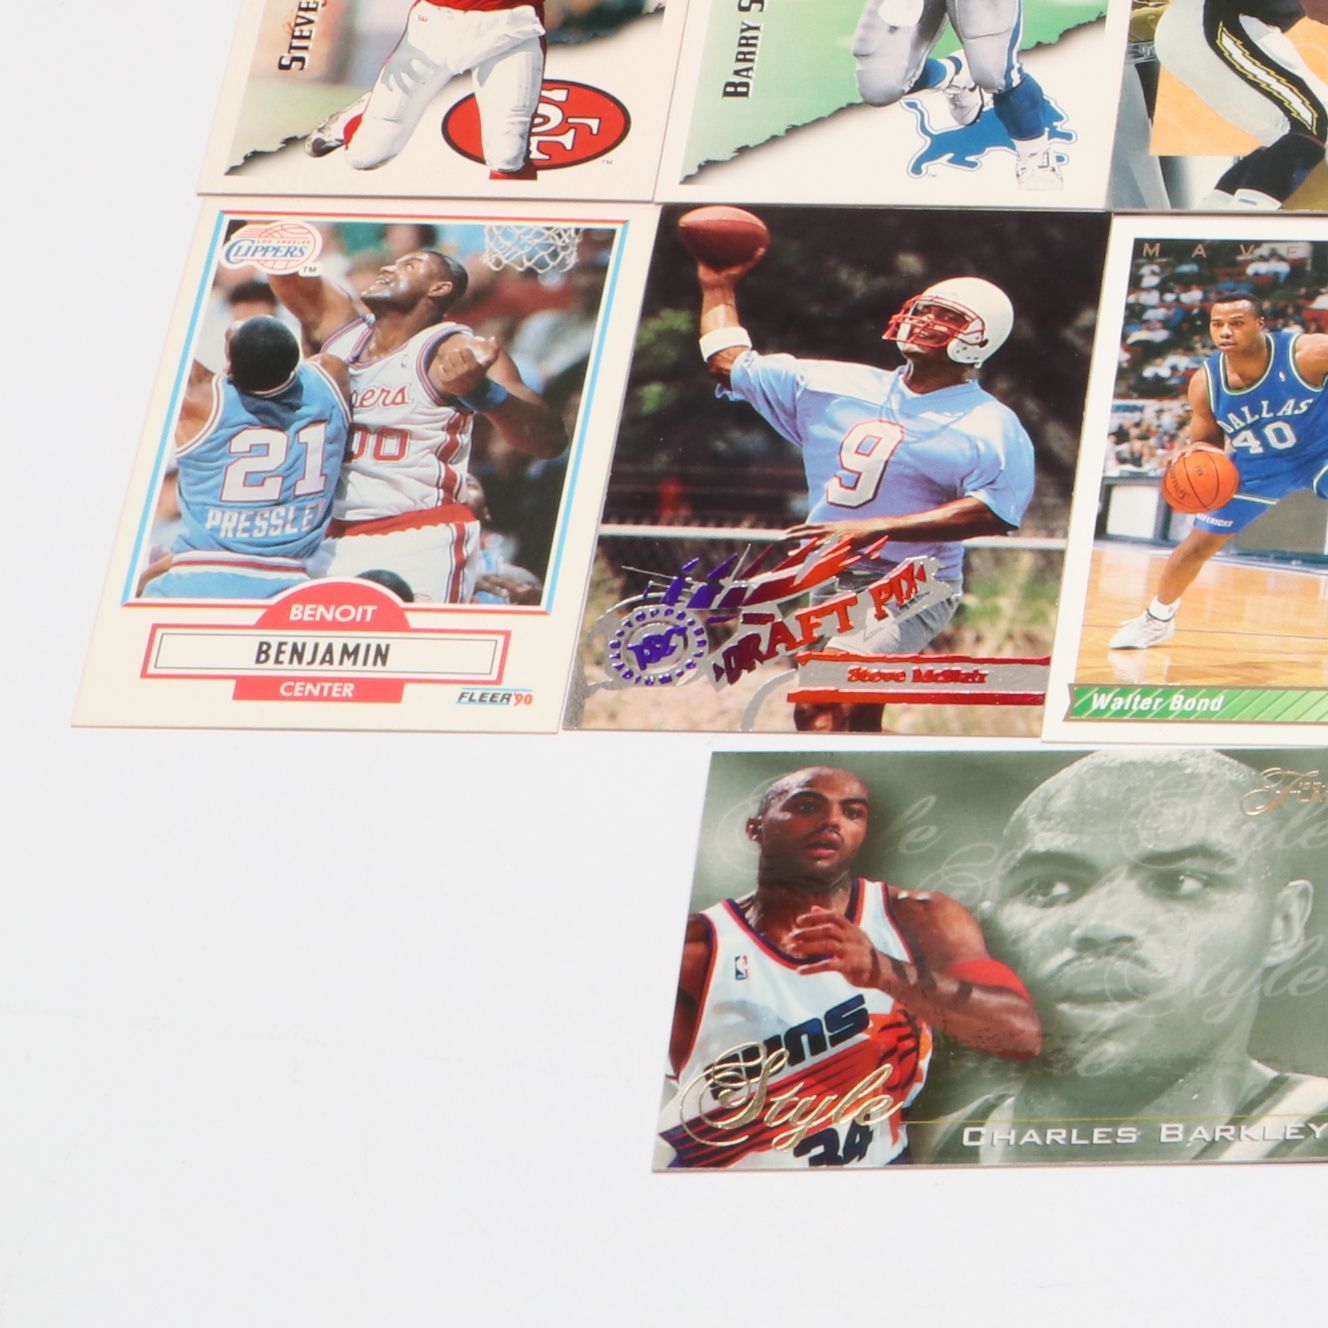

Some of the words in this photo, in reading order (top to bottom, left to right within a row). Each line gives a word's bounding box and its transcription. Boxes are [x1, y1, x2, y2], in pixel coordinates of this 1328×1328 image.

[722, 20, 763, 99] BARRY
[223, 239, 309, 264] CLIPPERS
[1218, 397, 1314, 433] DALLAS
[1231, 419, 1300, 455] 40
[219, 420, 331, 504] 21
[825, 418, 906, 510] 9
[287, 602, 378, 624] BENOIT
[253, 638, 392, 667] BENJAMIN
[719, 590, 858, 686] DRAFT
[278, 679, 356, 699] CENTER
[847, 665, 907, 684] Steve
[1090, 691, 1163, 713] Walter
[1168, 692, 1226, 714] Bond
[678, 1040, 903, 1154] Style
[961, 1125, 1139, 1150] CHARLES
